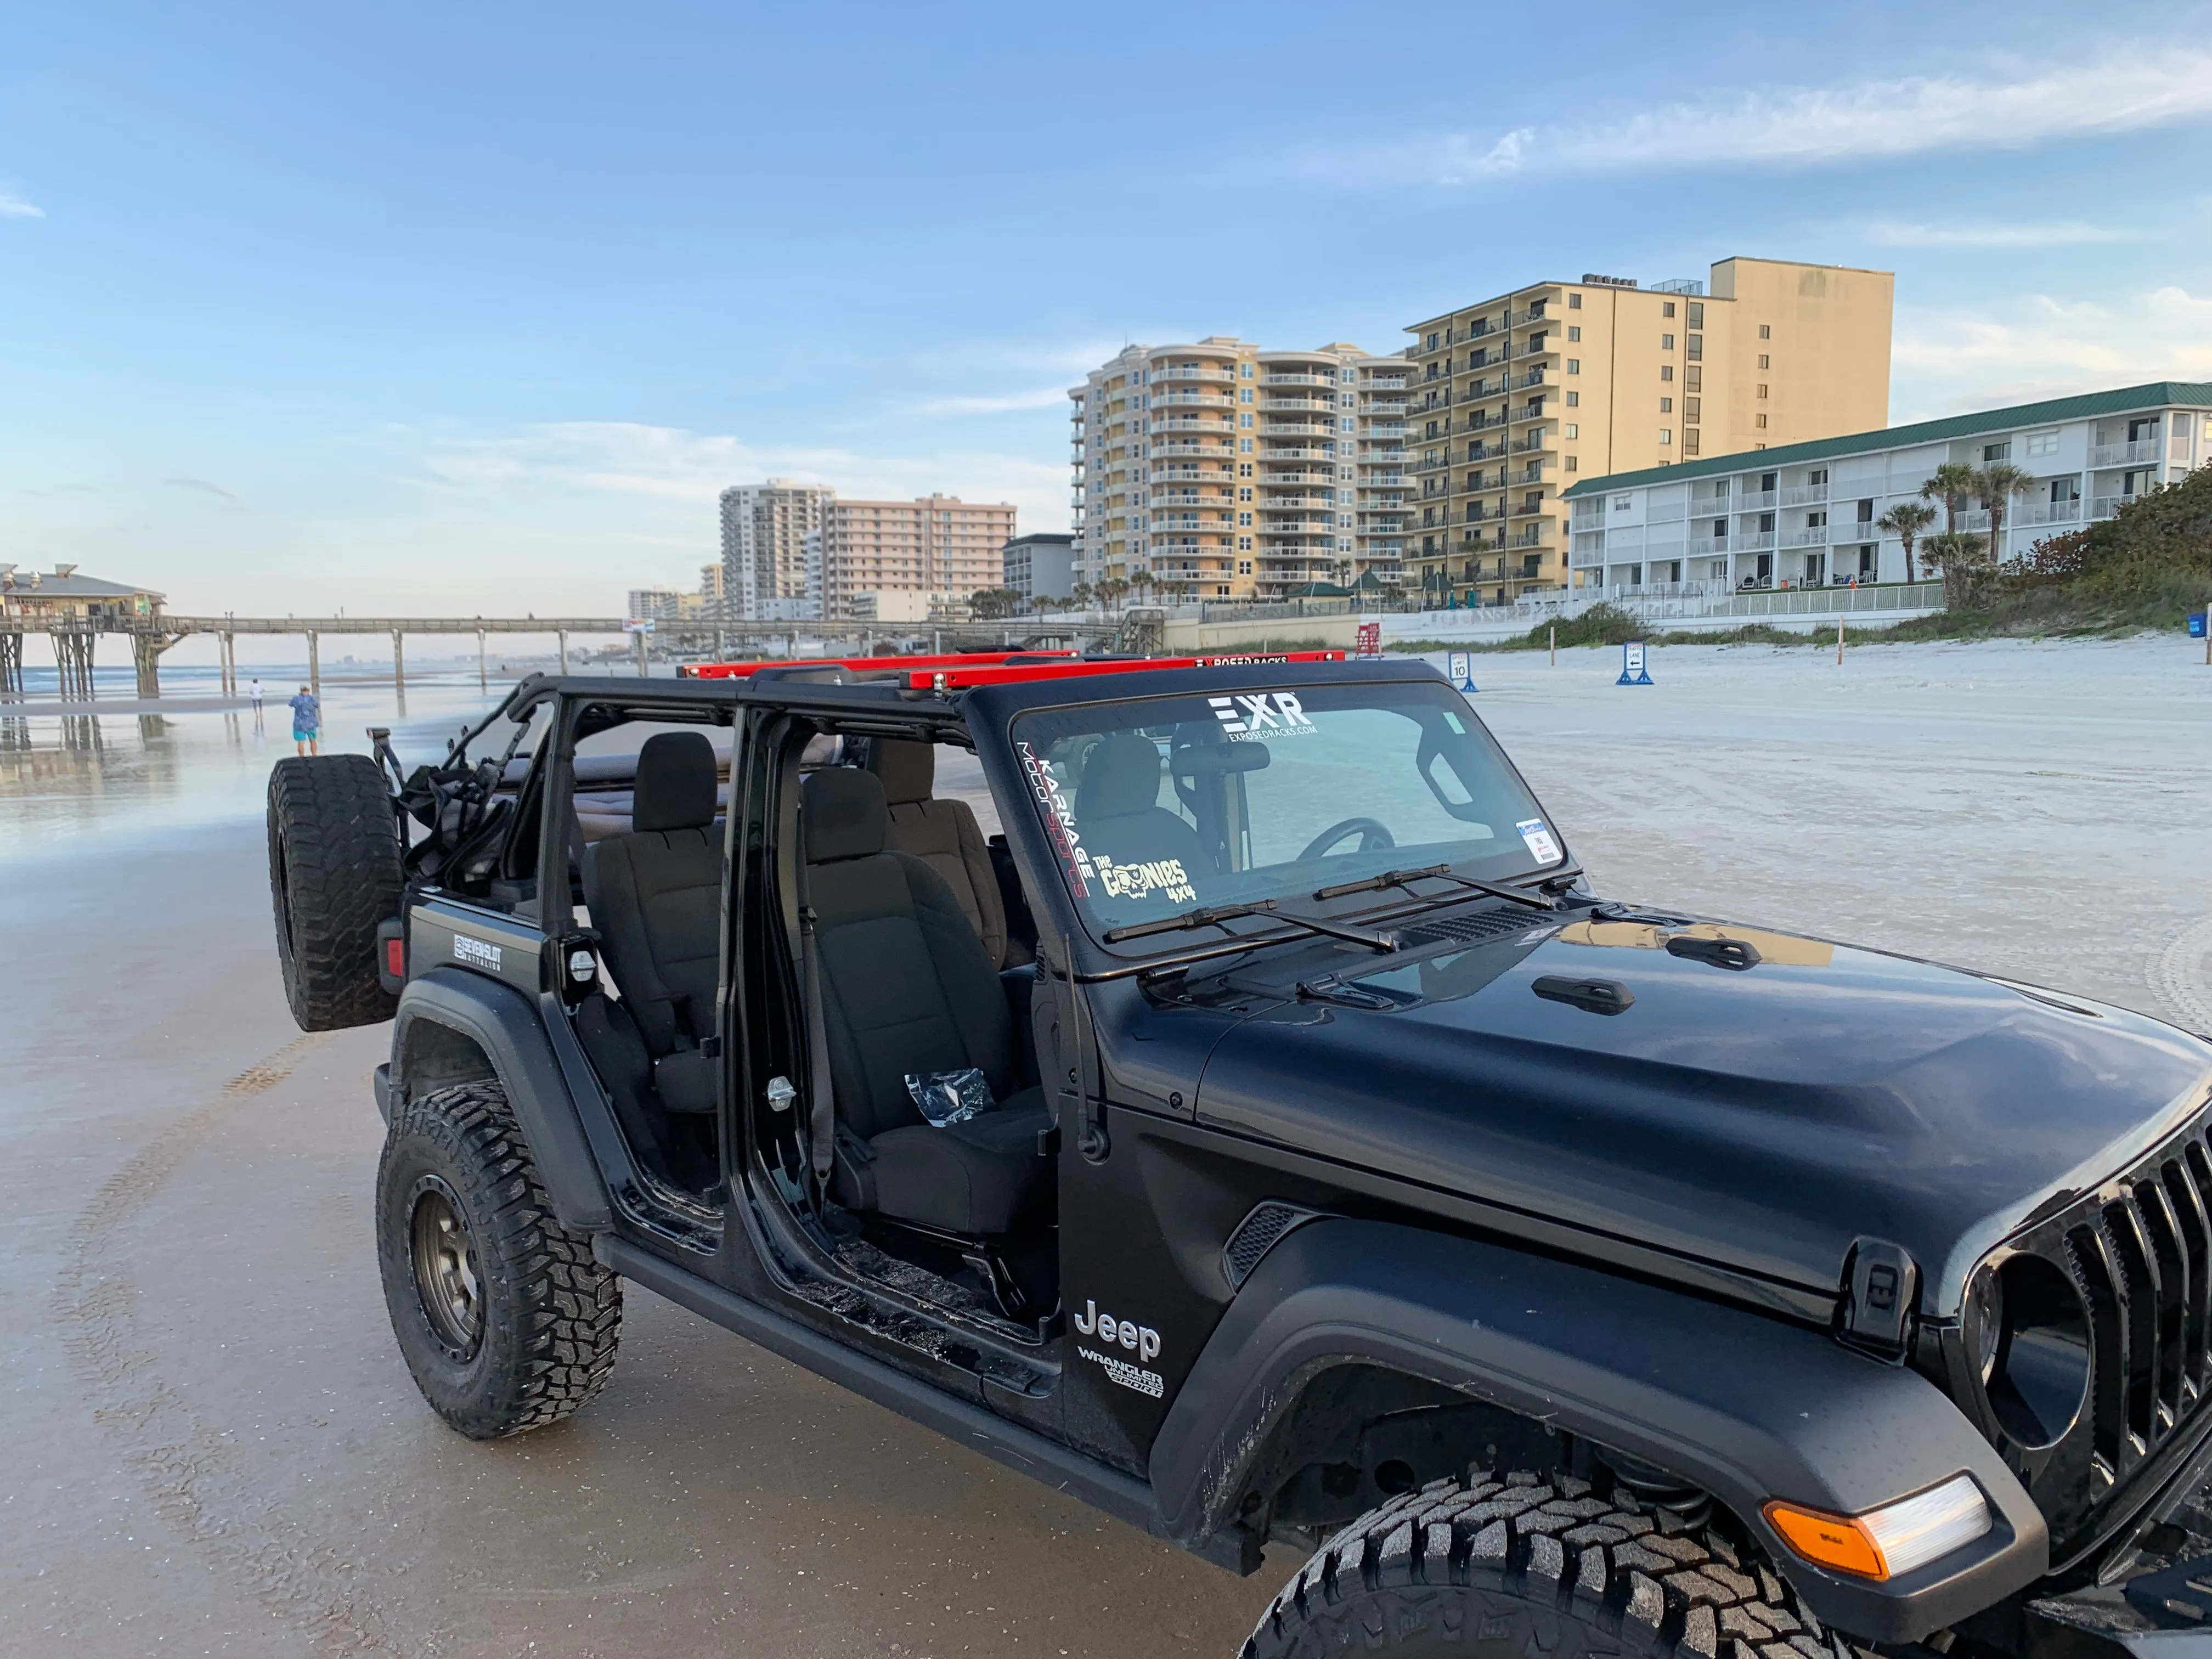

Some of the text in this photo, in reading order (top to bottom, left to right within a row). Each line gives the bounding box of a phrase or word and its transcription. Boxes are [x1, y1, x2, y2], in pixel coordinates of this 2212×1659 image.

[1454, 666, 1465, 676] 10
[1207, 692, 1312, 732] EXR
[1228, 726, 1318, 742] EXPOSEDRACKS.COM
[1039, 760, 1094, 878] KARNAGE
[1074, 1299, 1161, 1363] Jeep
[1077, 1346, 1164, 1385] WRANGLER
[1104, 1364, 1164, 1390] UNLIMITED
[1109, 1374, 1162, 1397] SPORT
